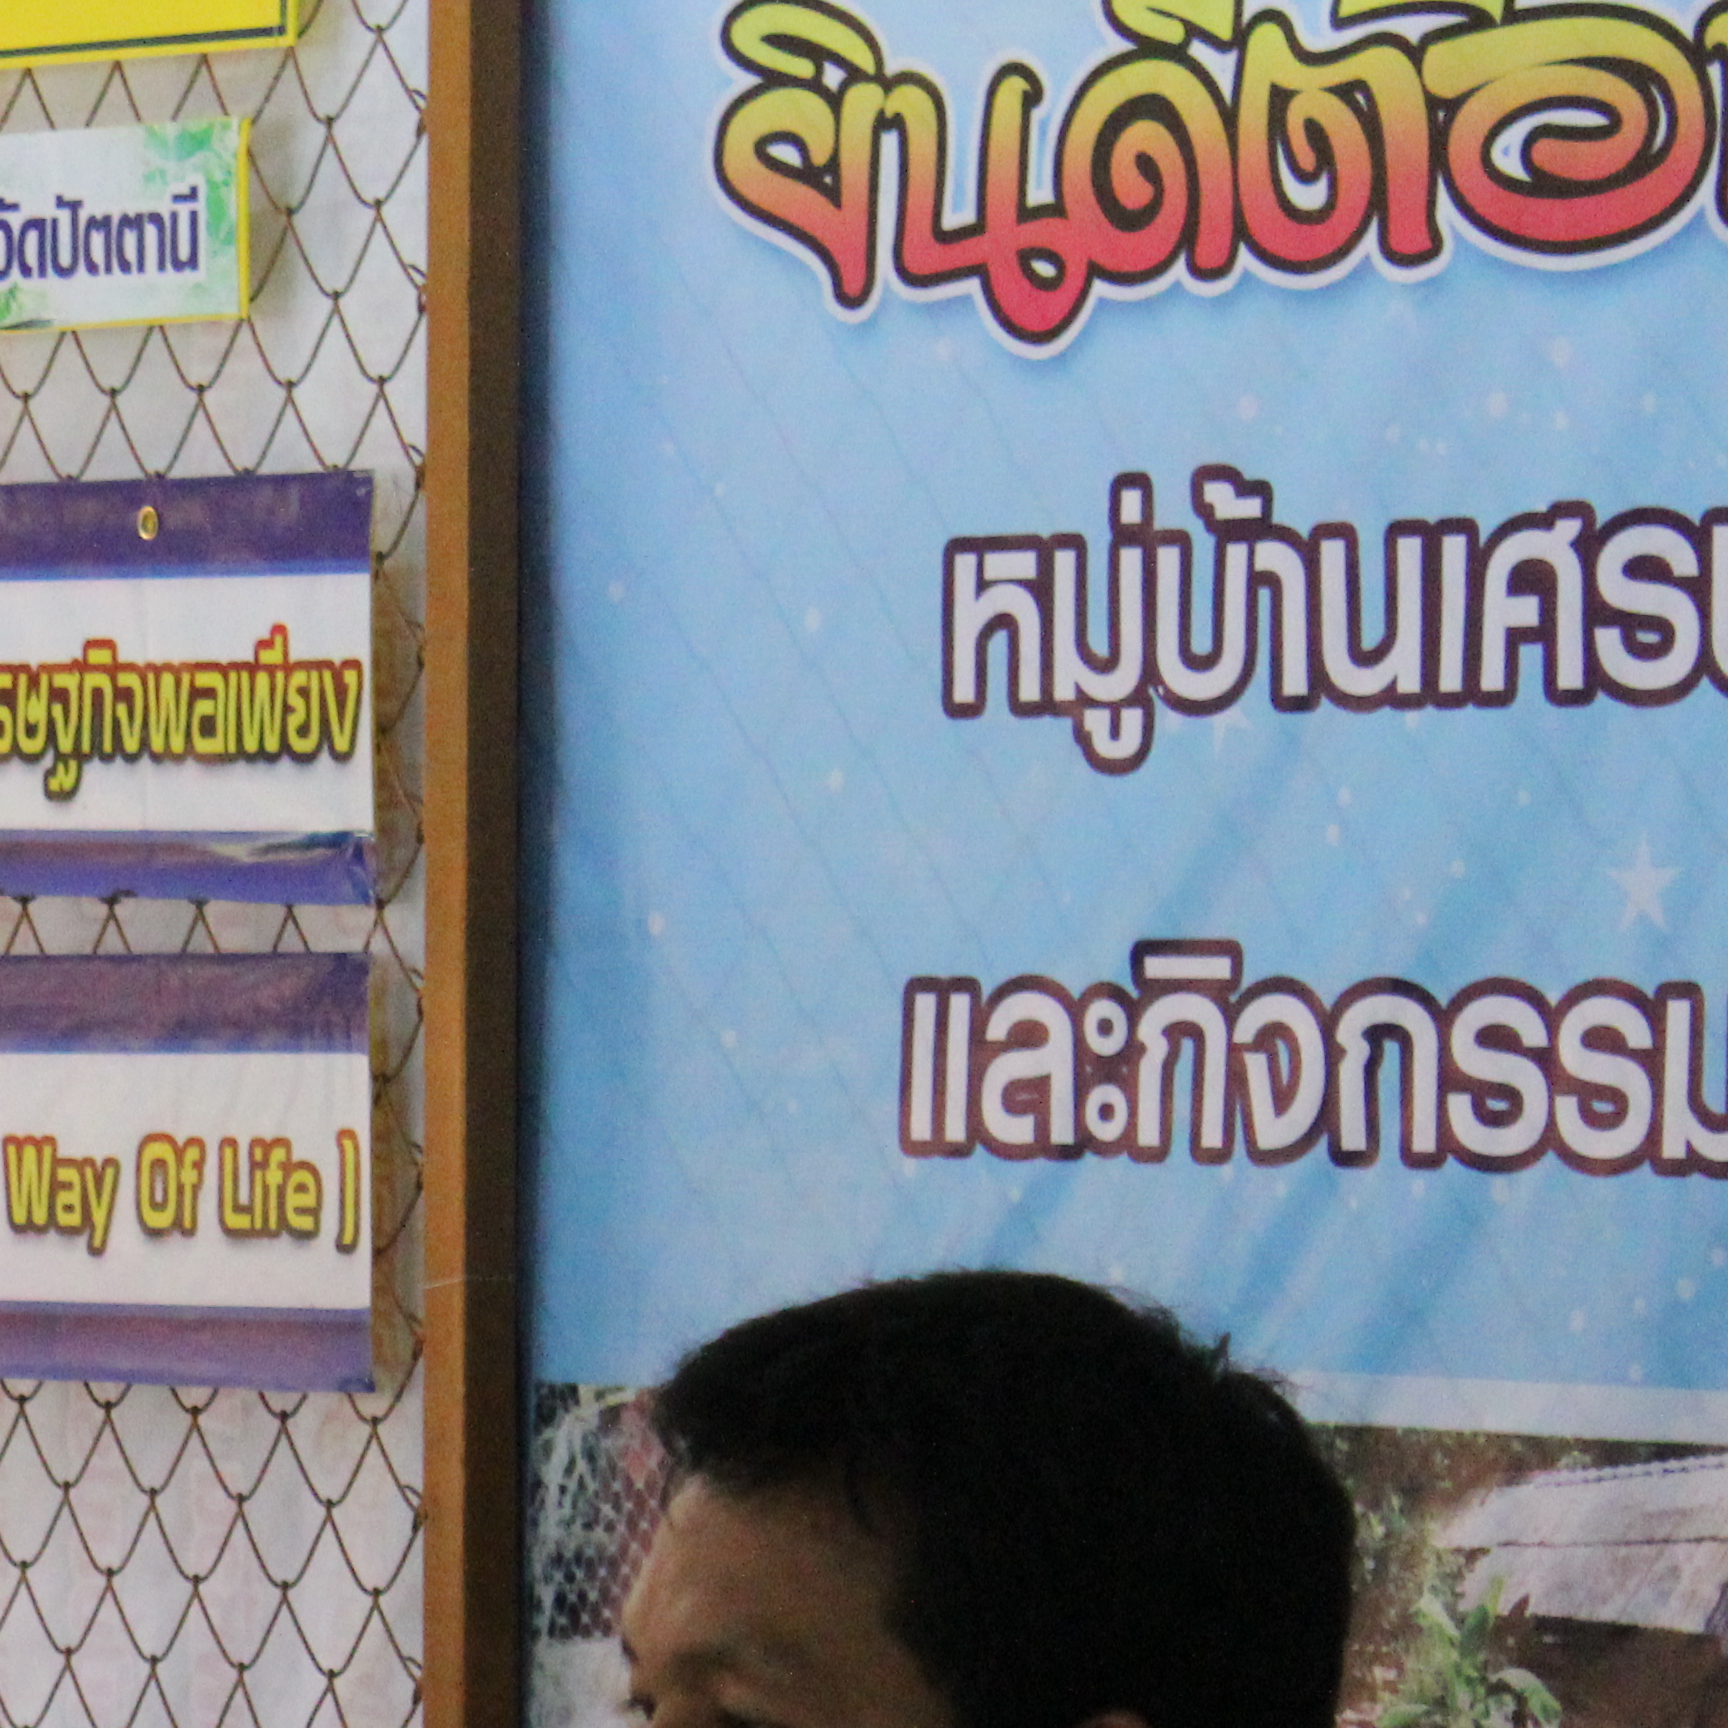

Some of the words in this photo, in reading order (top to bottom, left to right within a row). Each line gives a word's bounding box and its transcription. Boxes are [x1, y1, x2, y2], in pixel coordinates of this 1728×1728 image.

[943, 465, 1728, 774] หมู่บ้านเศร
[2, 1134, 121, 1256] Way
[137, 1131, 206, 1237] Of
[219, 1136, 323, 1240] Life
